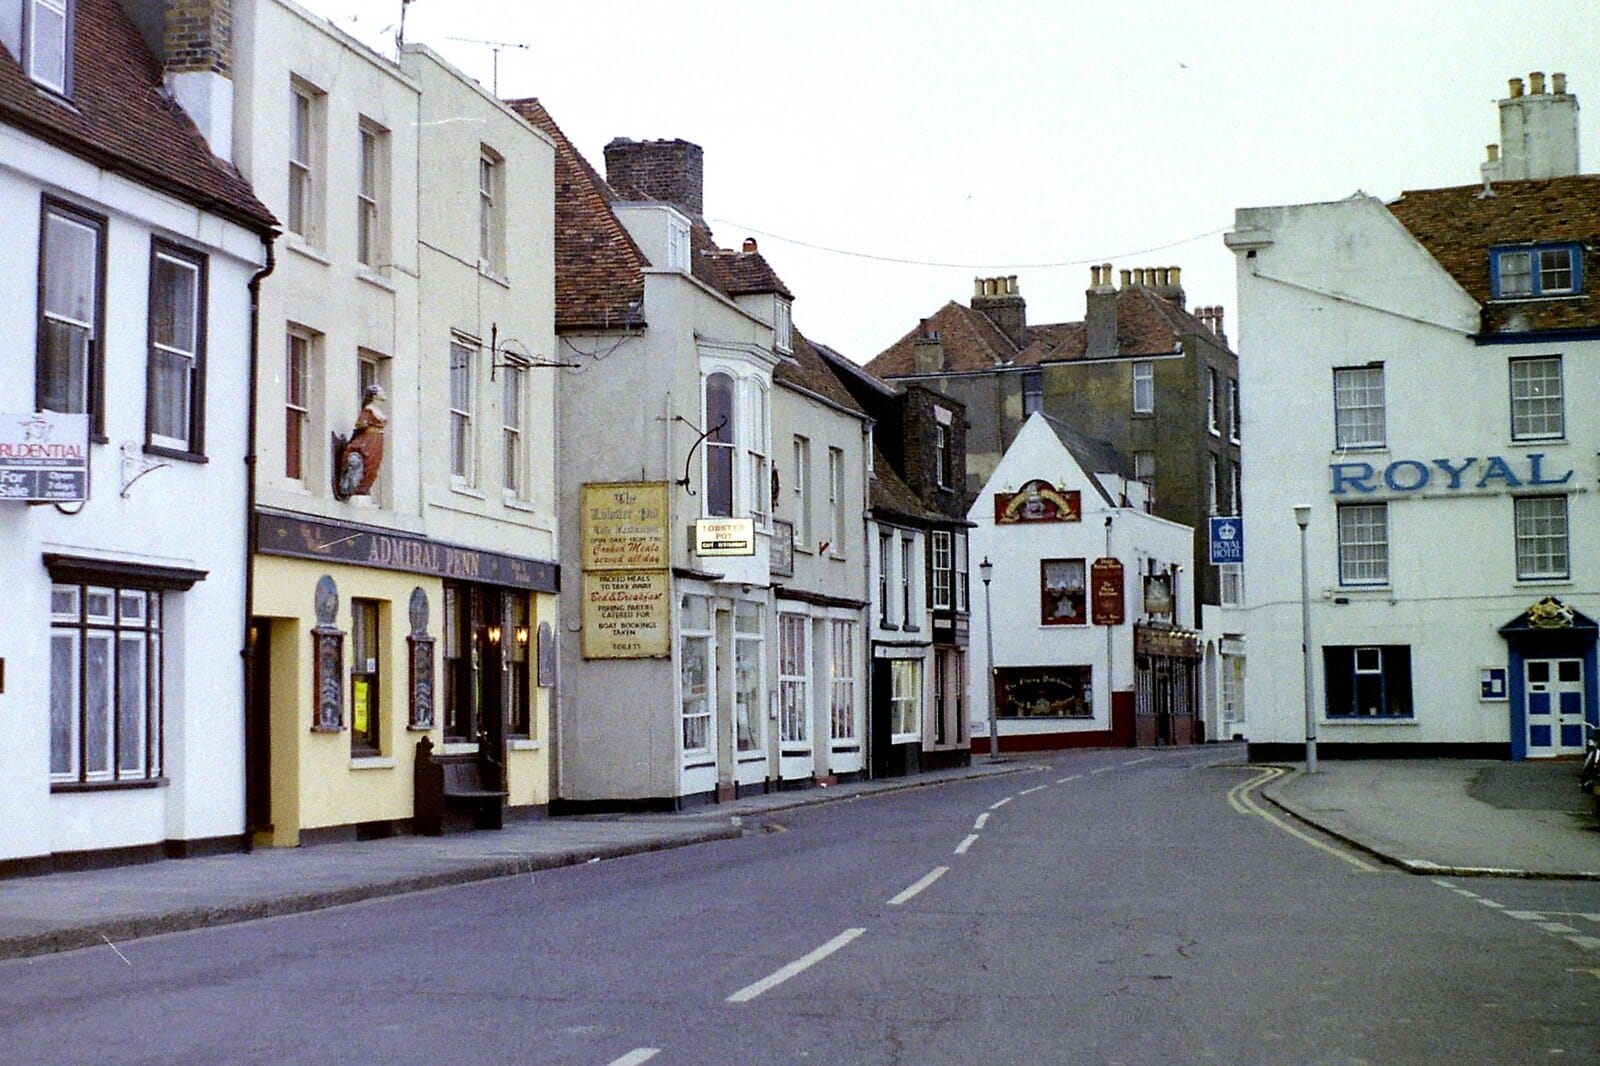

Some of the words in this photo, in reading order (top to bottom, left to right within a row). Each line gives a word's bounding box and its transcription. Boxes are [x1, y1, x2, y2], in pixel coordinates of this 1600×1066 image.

[0, 470, 26, 483] For
[1329, 453, 1574, 495] ROYAL
[0, 484, 28, 497] Sale
[715, 532, 733, 540] POT
[1213, 540, 1240, 549] ROYAL
[367, 535, 439, 571] ADMIRAL
[447, 549, 480, 577] PENN
[1213, 549, 1240, 558] HOTEL
[598, 604, 625, 612] FISHING
[598, 622, 617, 630] BOAT
